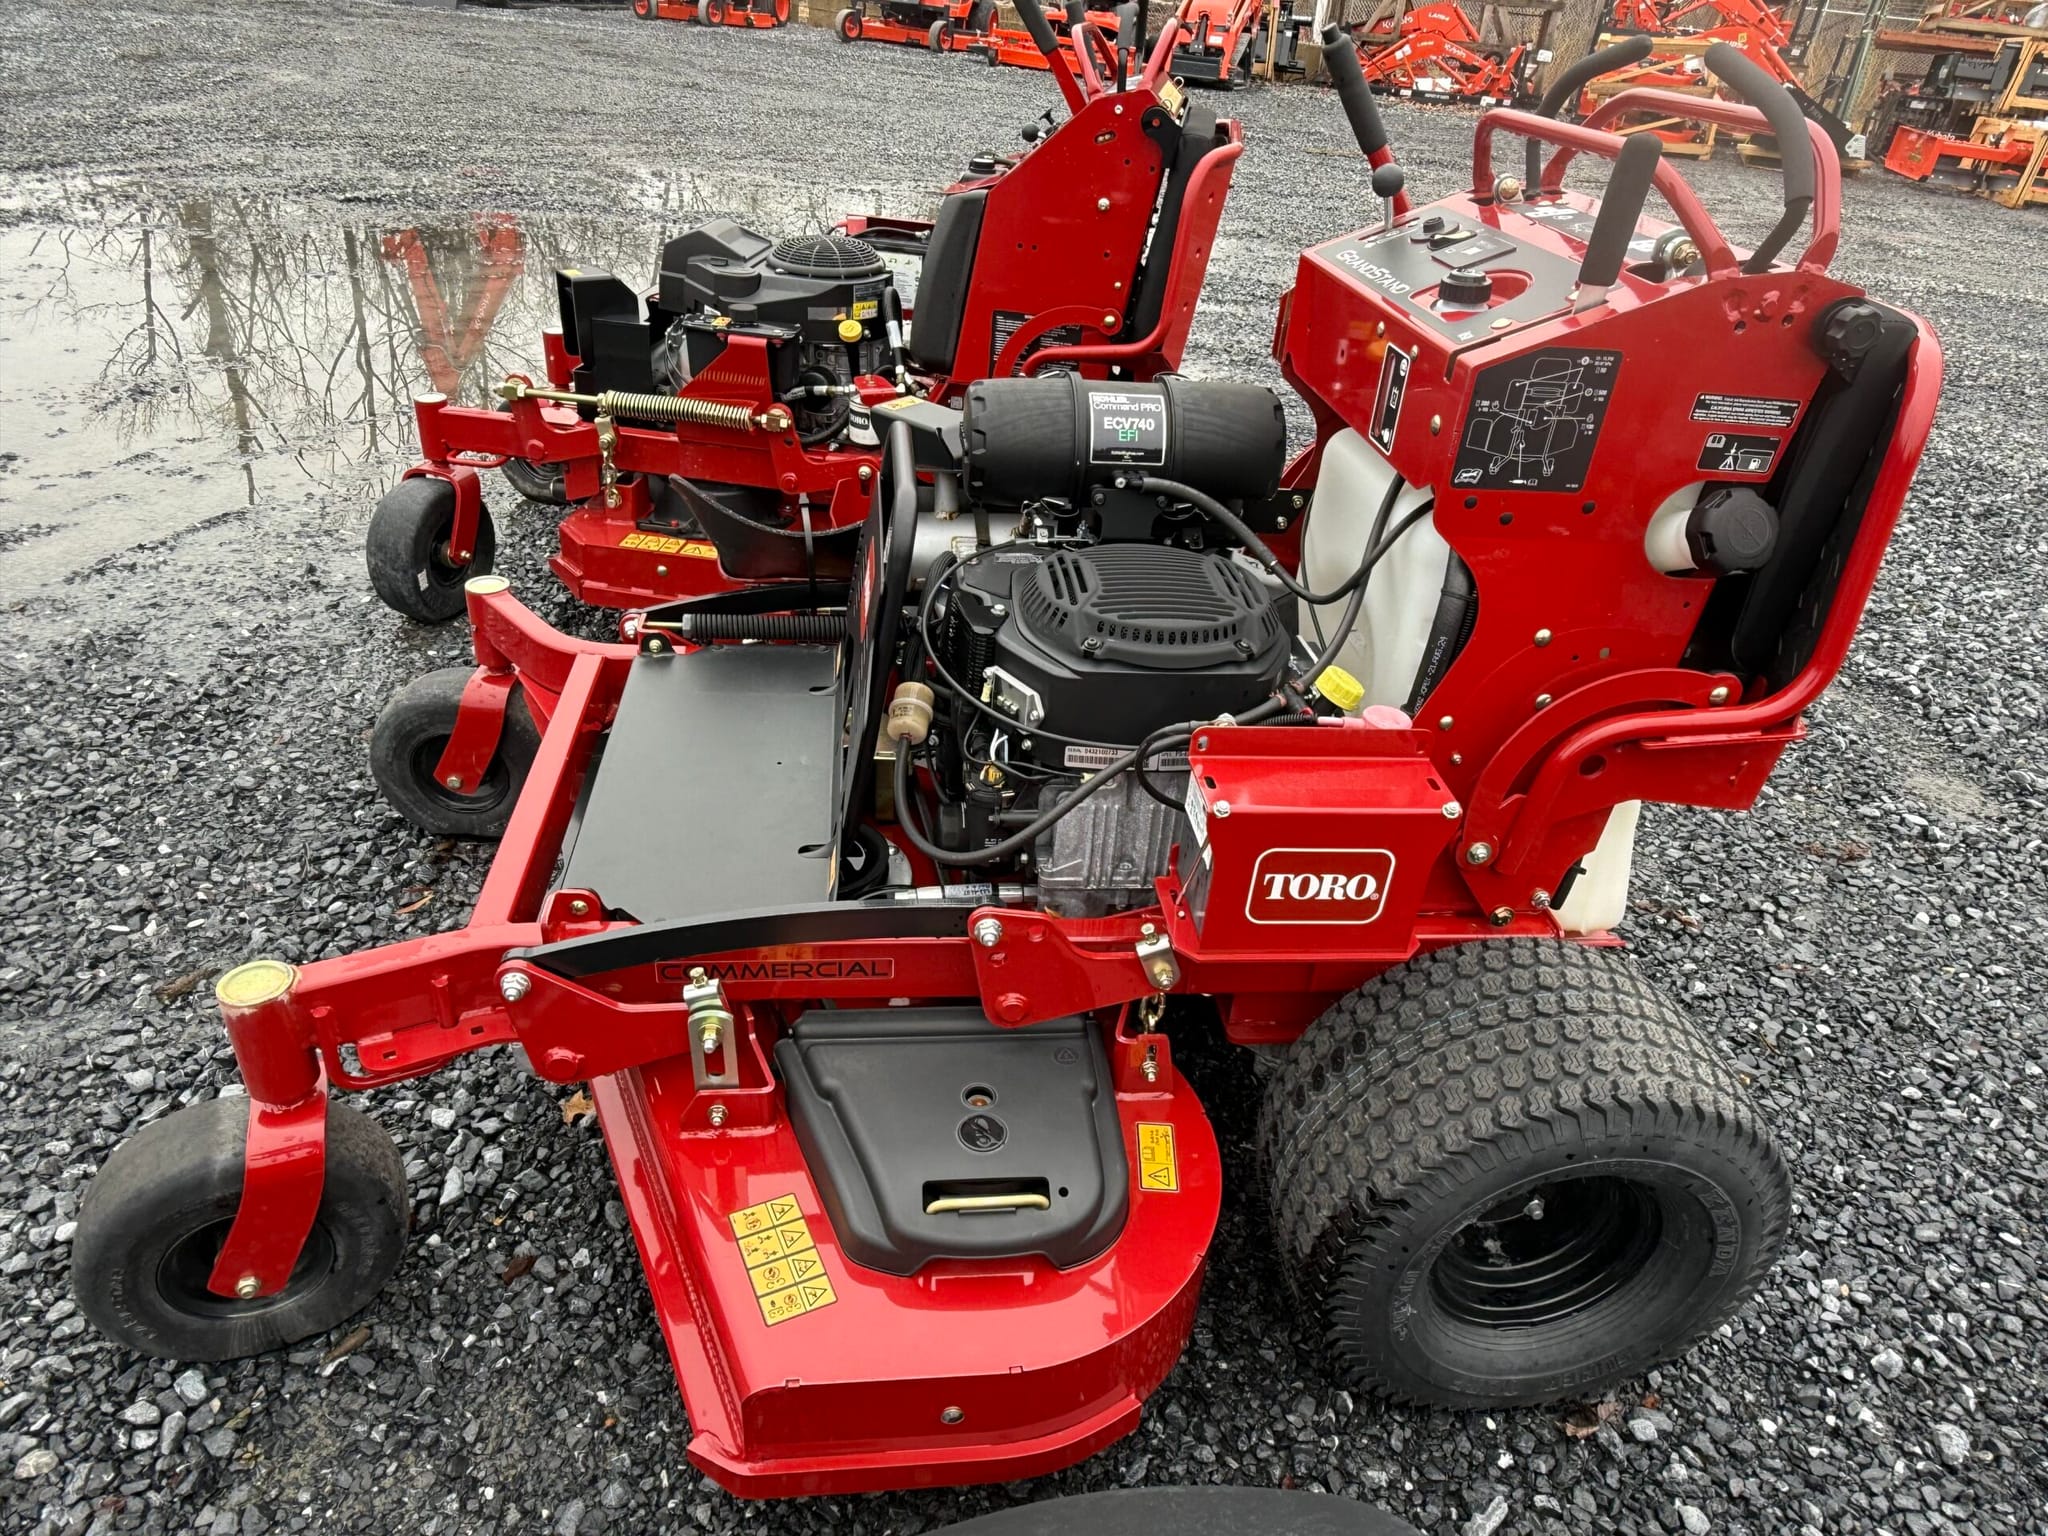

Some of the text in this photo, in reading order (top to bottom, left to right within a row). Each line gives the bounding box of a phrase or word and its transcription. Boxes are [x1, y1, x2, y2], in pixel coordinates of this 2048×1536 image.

[1093, 401, 1162, 413] Command PRO
[1103, 416, 1156, 431] ECV740
[1118, 429, 1139, 442] EFI
[1263, 873, 1379, 901] TORO
